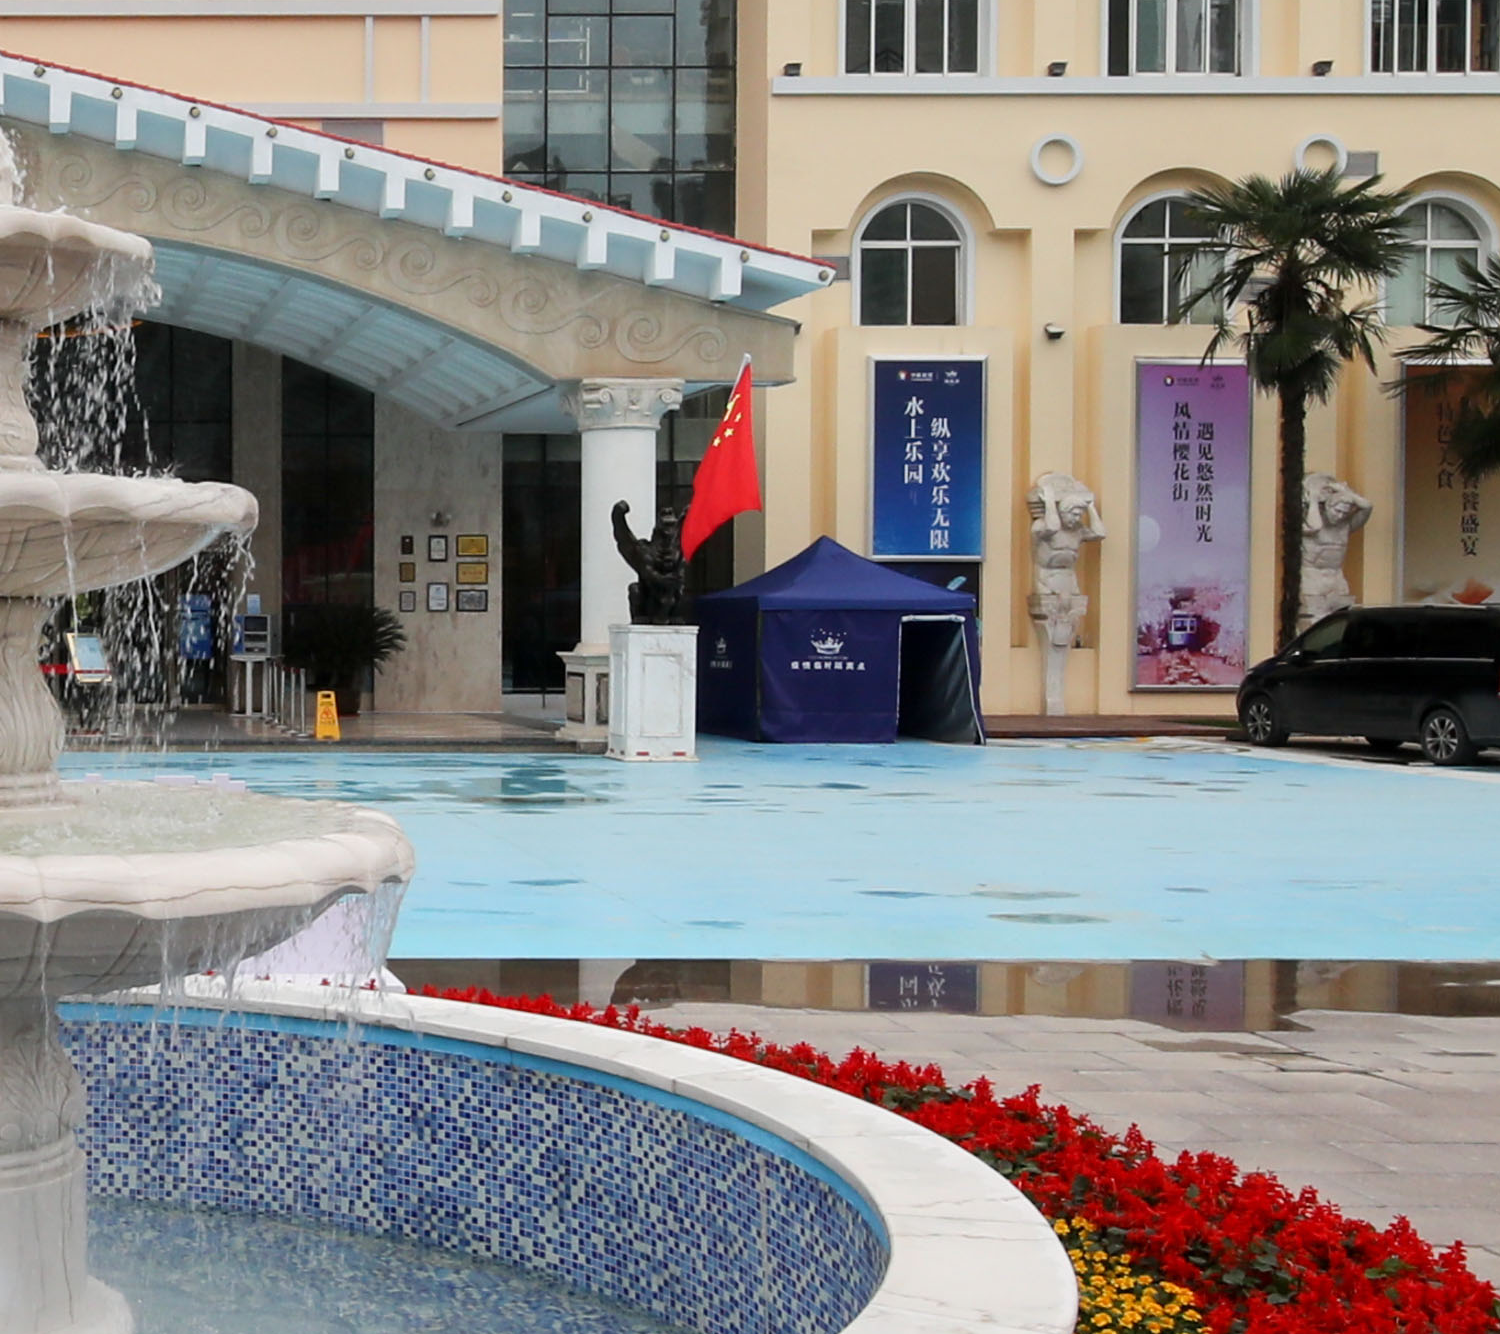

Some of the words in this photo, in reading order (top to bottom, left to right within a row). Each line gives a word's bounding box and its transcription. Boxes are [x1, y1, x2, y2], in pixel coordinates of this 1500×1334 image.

[904, 395, 924, 484] 水上乐园
[929, 417, 951, 550] 纵享欢乐无限
[1173, 402, 1191, 502] 风情樱花街
[1195, 422, 1214, 543] 遇见悠然时光
